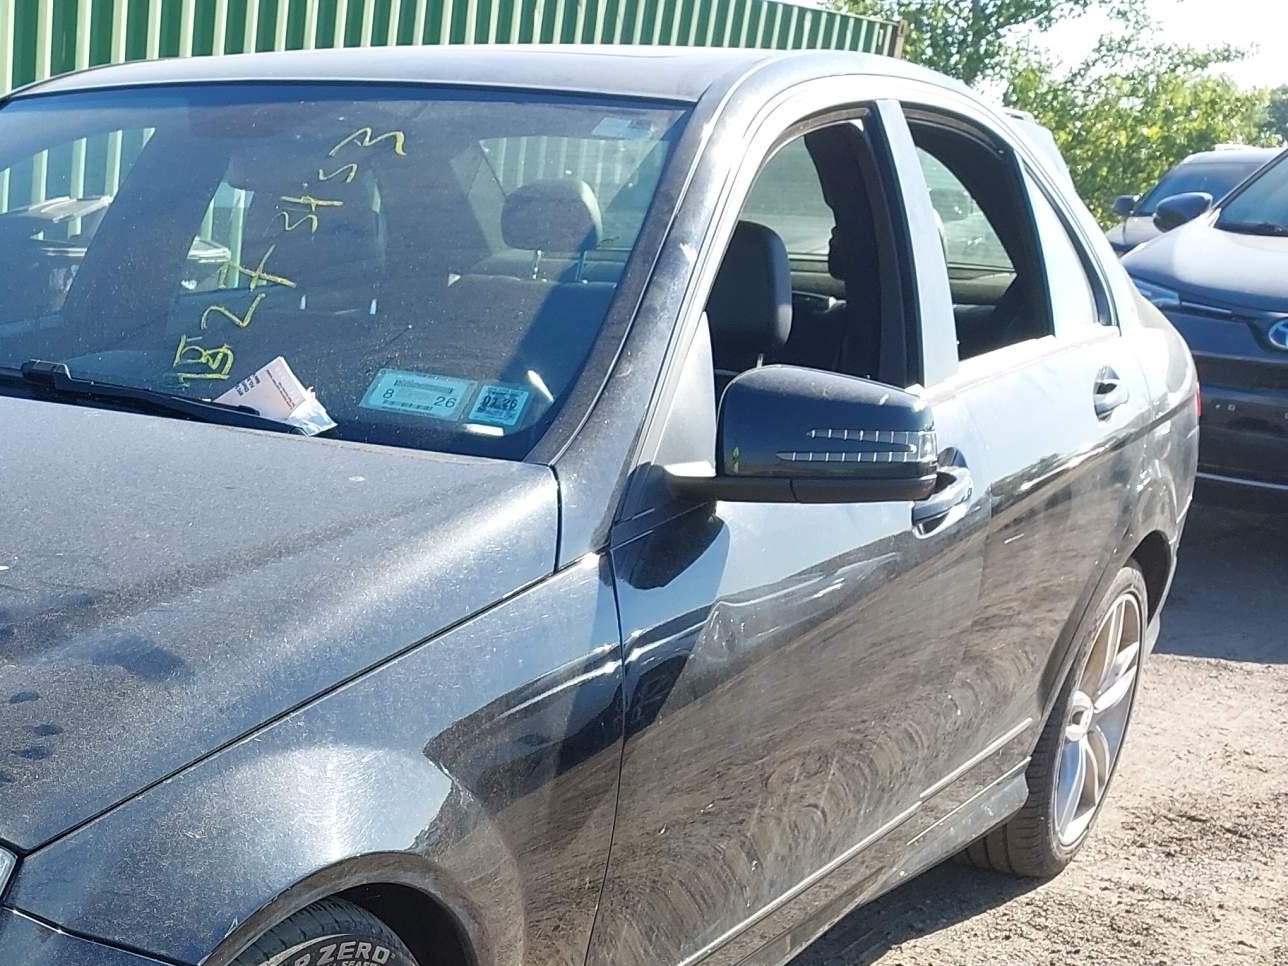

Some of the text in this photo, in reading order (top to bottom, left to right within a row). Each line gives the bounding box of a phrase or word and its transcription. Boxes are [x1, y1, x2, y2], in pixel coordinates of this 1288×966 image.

[383, 388, 395, 399] 8
[433, 395, 457, 409] 26
[316, 941, 390, 966] ZERO
